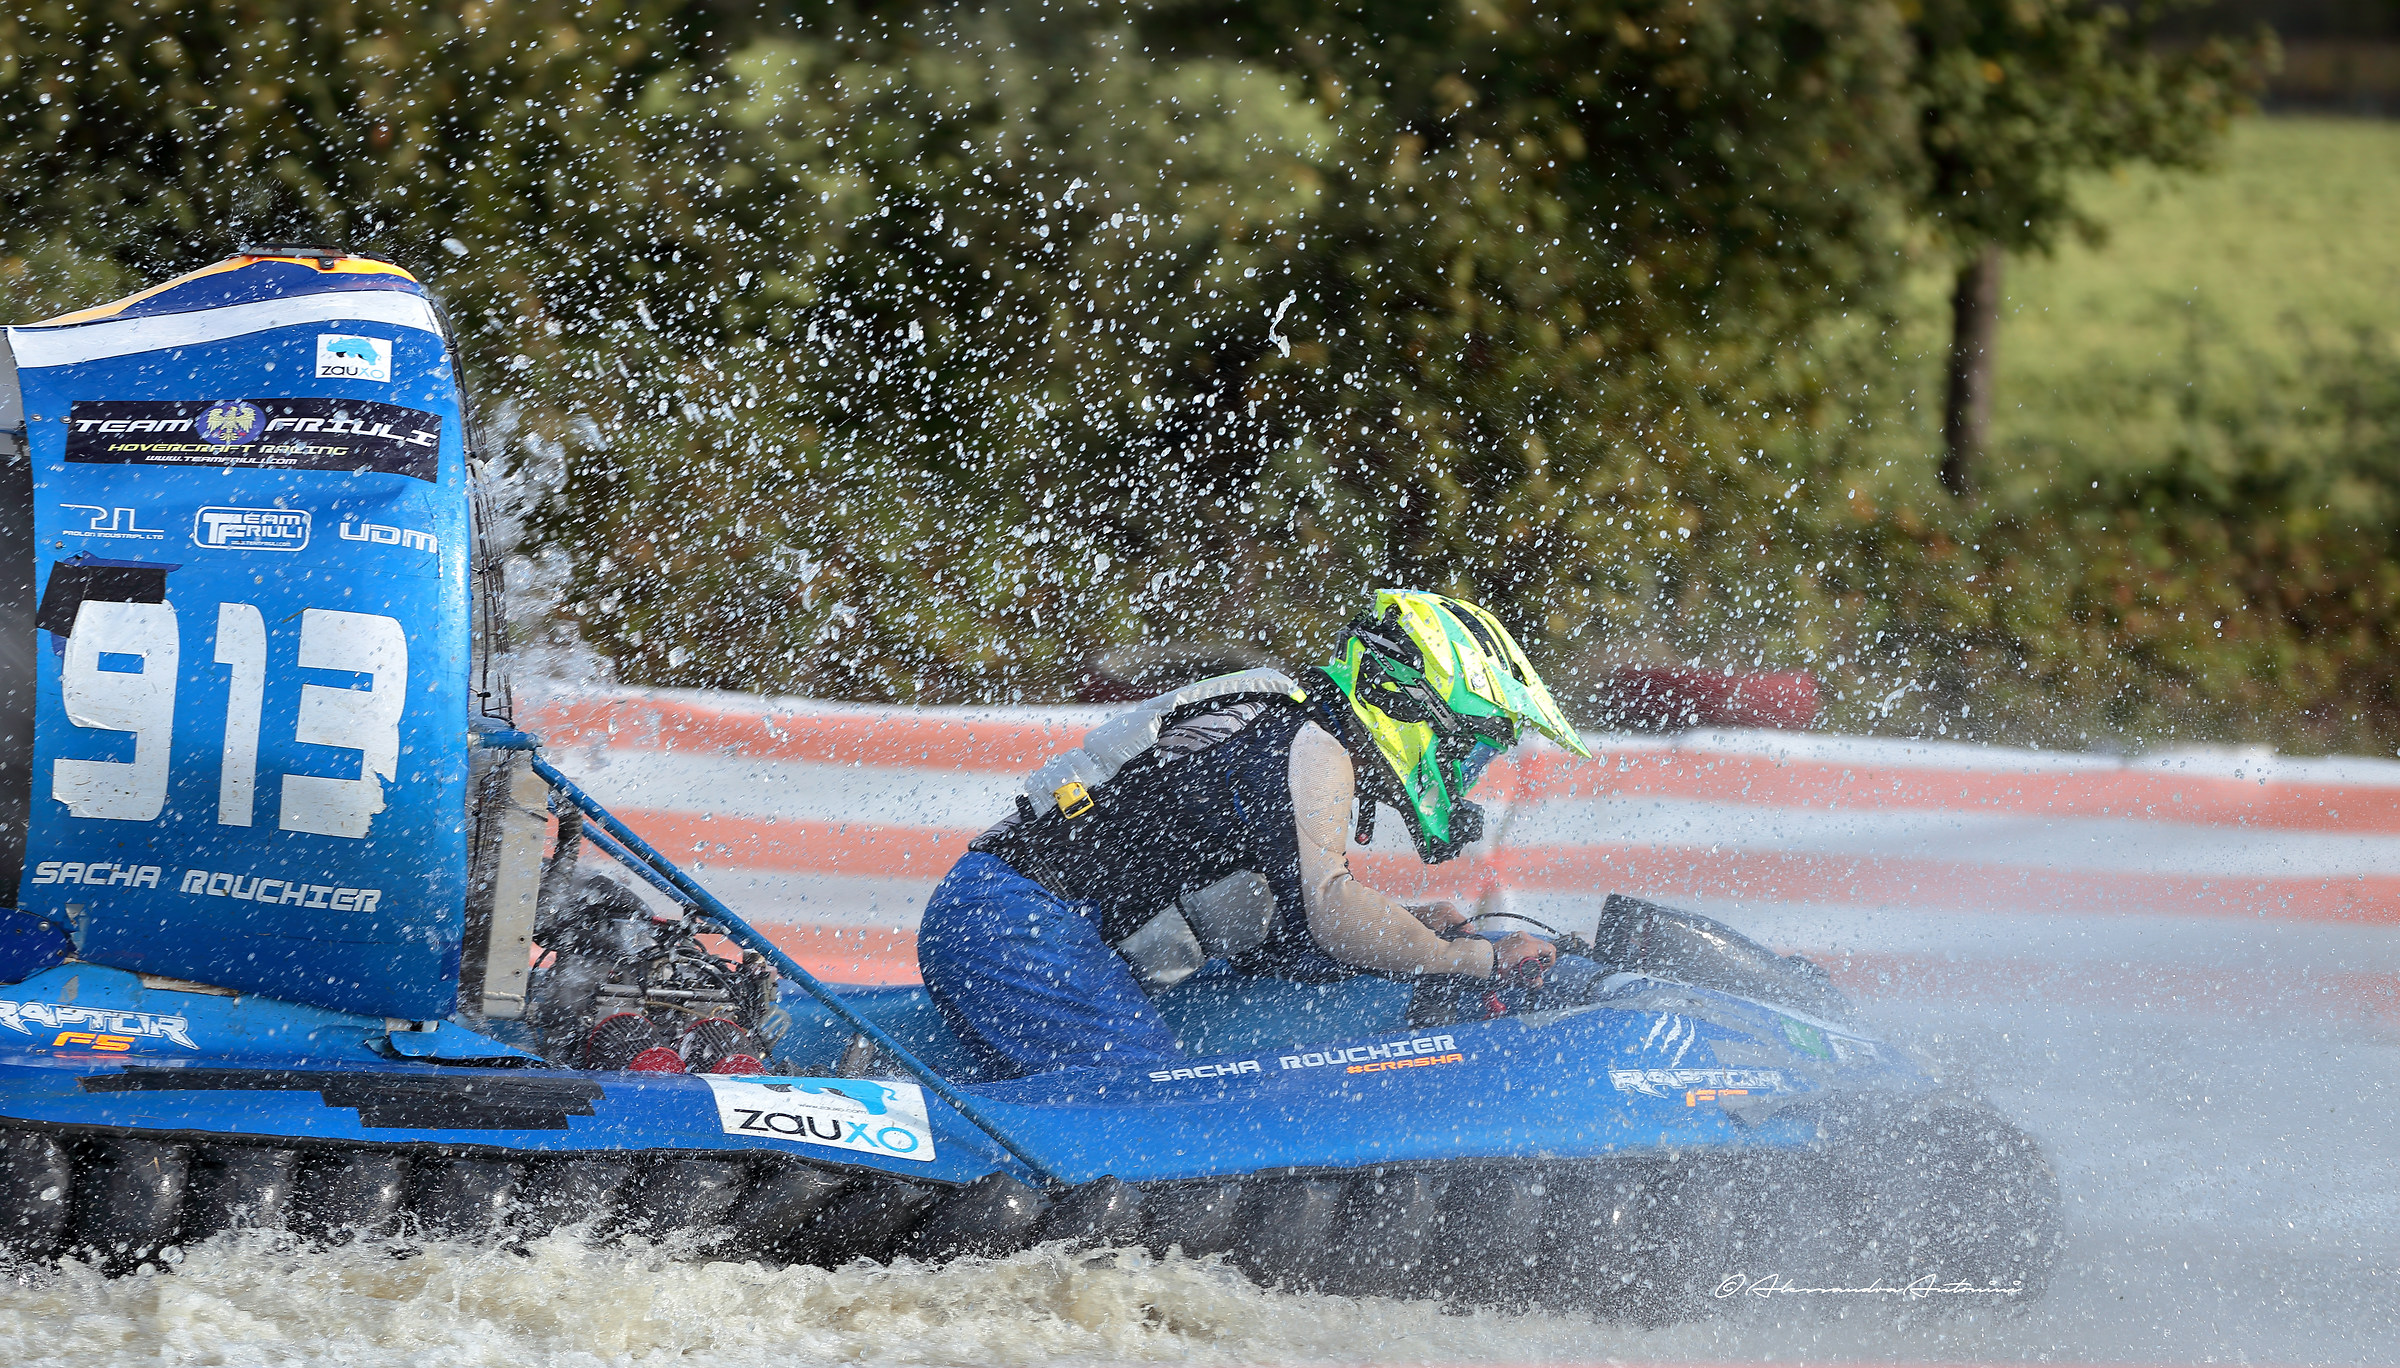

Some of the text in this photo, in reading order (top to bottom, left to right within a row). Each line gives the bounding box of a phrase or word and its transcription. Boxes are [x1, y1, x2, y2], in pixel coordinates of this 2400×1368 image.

[321, 365, 385, 380] zauxo
[74, 417, 438, 448] TEAM FRIULI
[107, 443, 349, 457] HOVERCRAFT RACING
[52, 599, 409, 839] 913
[31, 861, 382, 913] SACHA ROUCHIER
[0, 1000, 200, 1051] RAPTOR
[1148, 1034, 1458, 1082] SACHA ROUCHIER
[1346, 1053, 1463, 1074] #CRASHA
[734, 1109, 919, 1153] zauxo
